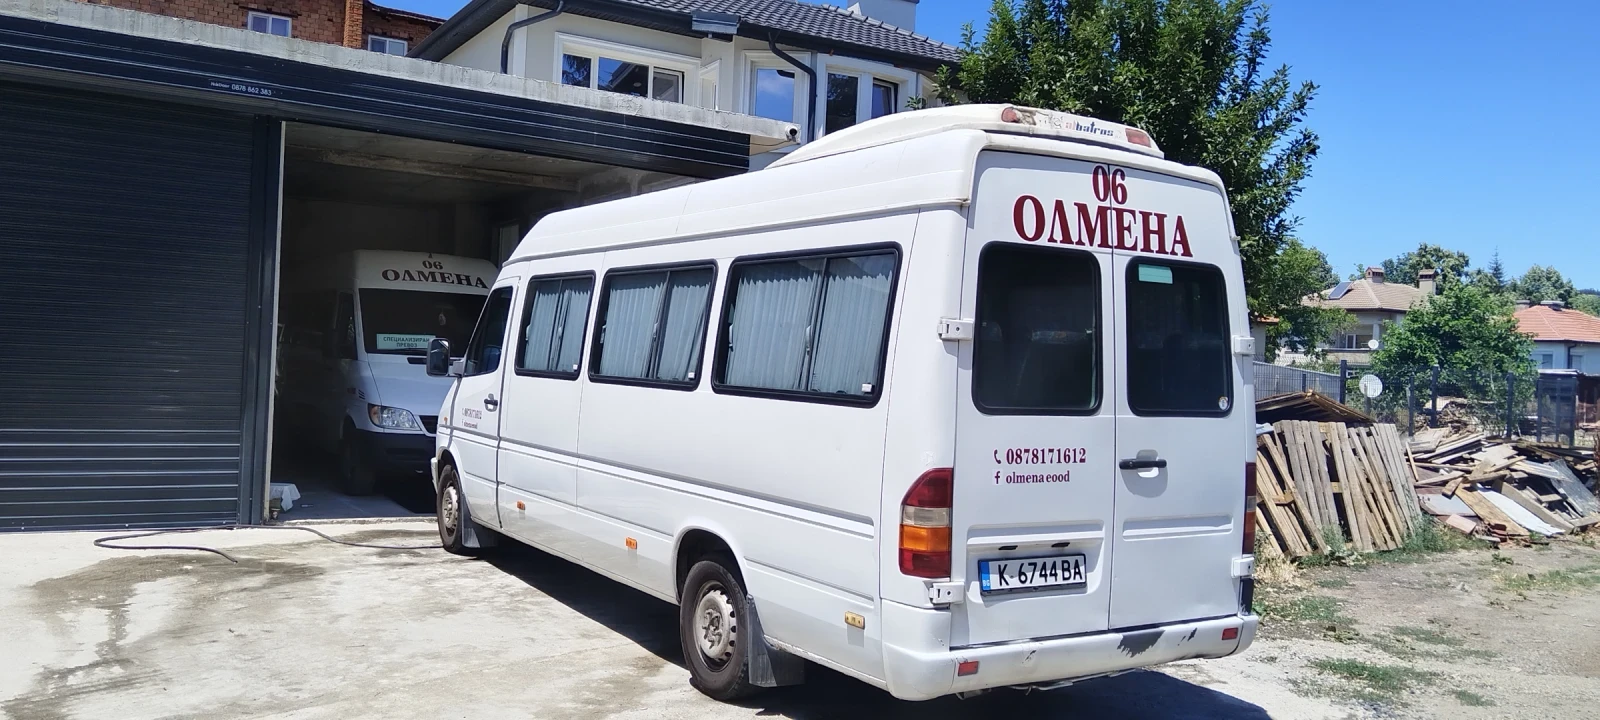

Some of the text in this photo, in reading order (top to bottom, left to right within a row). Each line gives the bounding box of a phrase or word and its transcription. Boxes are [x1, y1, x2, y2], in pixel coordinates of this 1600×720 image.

[1065, 119, 1114, 137] albatros
[1092, 165, 1128, 204] 06
[1013, 194, 1194, 257] ОЛМЕНА
[422, 260, 443, 270] 06
[381, 269, 489, 289] ОЛМЕНА
[1005, 448, 1087, 465] 0878171612
[1006, 472, 1044, 484] olmena
[1046, 470, 1070, 483] eood
